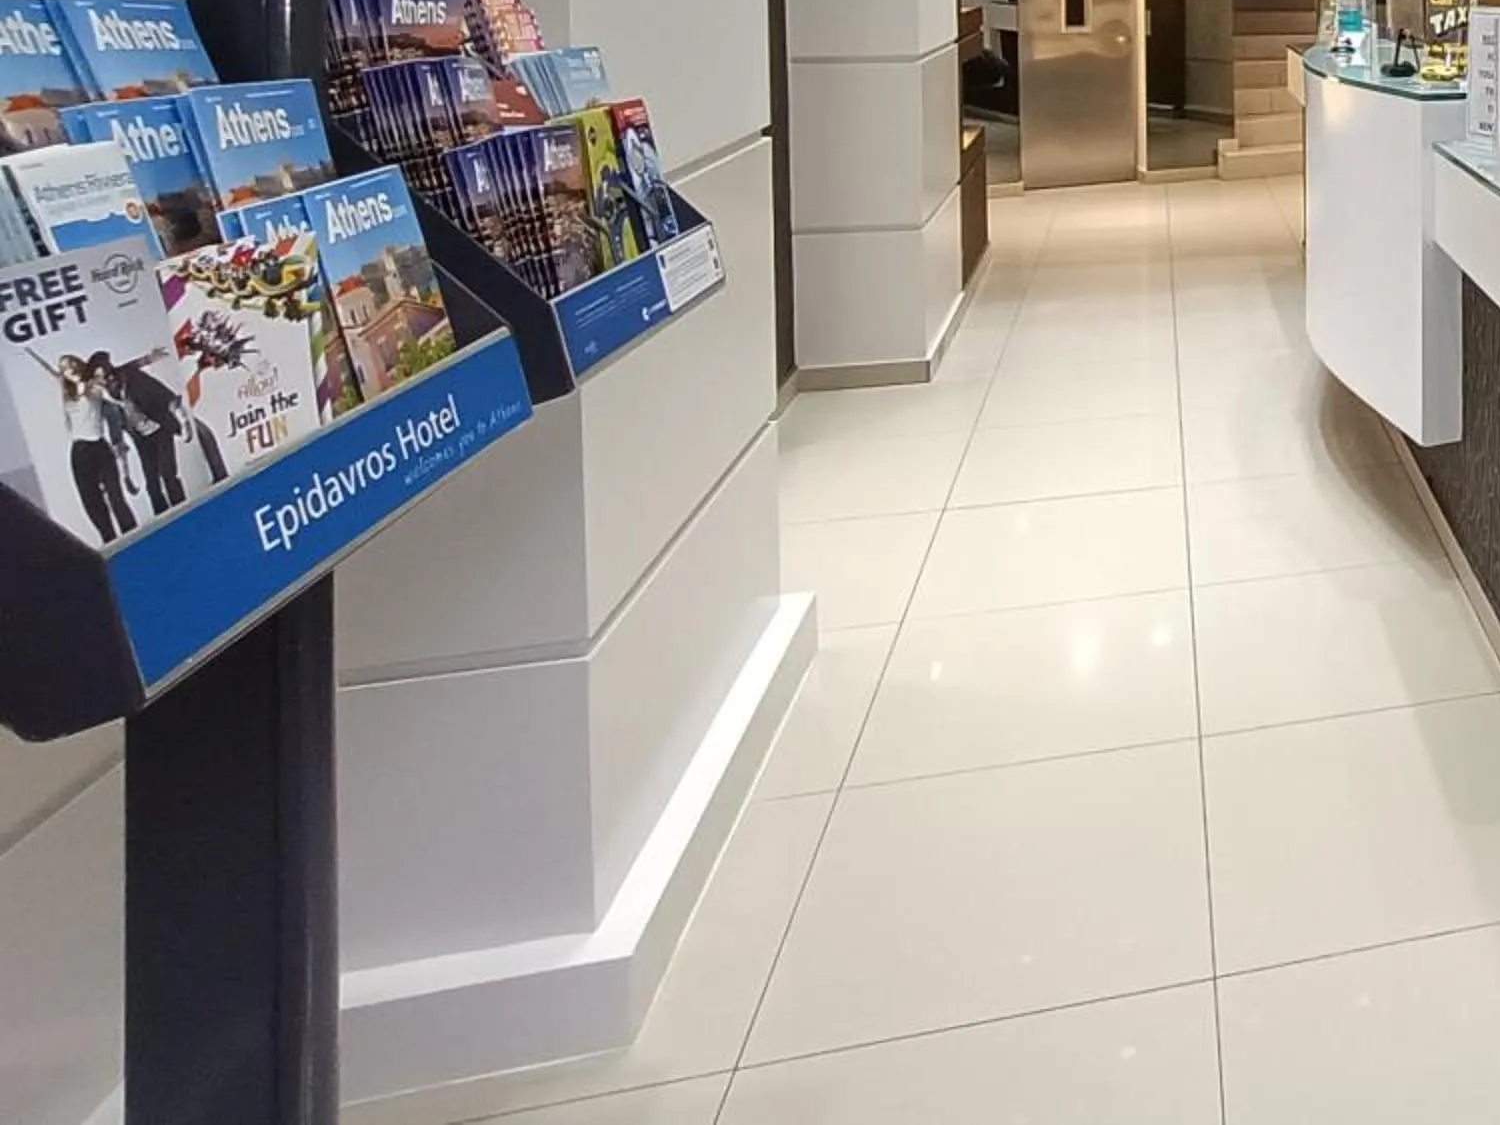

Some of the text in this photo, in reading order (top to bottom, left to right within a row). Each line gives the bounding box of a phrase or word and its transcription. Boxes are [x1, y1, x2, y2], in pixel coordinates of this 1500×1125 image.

[87, 8, 181, 52] Athens
[214, 102, 291, 150] Athens
[326, 191, 393, 244] Athens
[0, 264, 84, 313] FREE
[4, 296, 88, 343] GIFT
[228, 391, 299, 438] Join the
[246, 415, 289, 454] FUN
[254, 393, 461, 552] Epidavros Hotel
